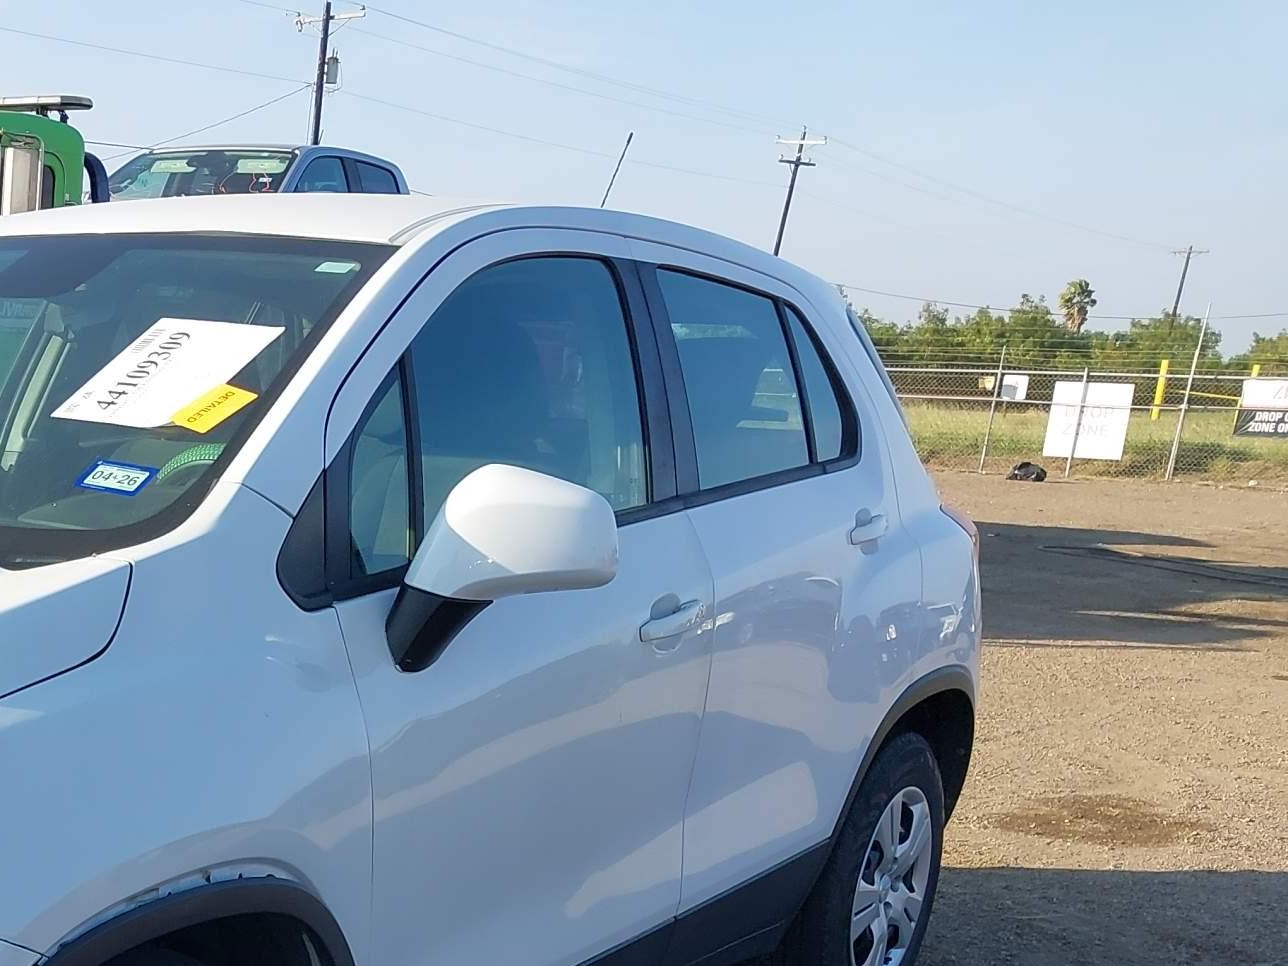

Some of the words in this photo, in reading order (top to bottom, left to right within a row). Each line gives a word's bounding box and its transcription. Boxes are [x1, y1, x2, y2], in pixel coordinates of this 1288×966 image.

[96, 332, 191, 410] 44109309
[187, 391, 235, 423] DETAILED
[1255, 411, 1283, 422] DROP
[1248, 422, 1276, 432] ZONE
